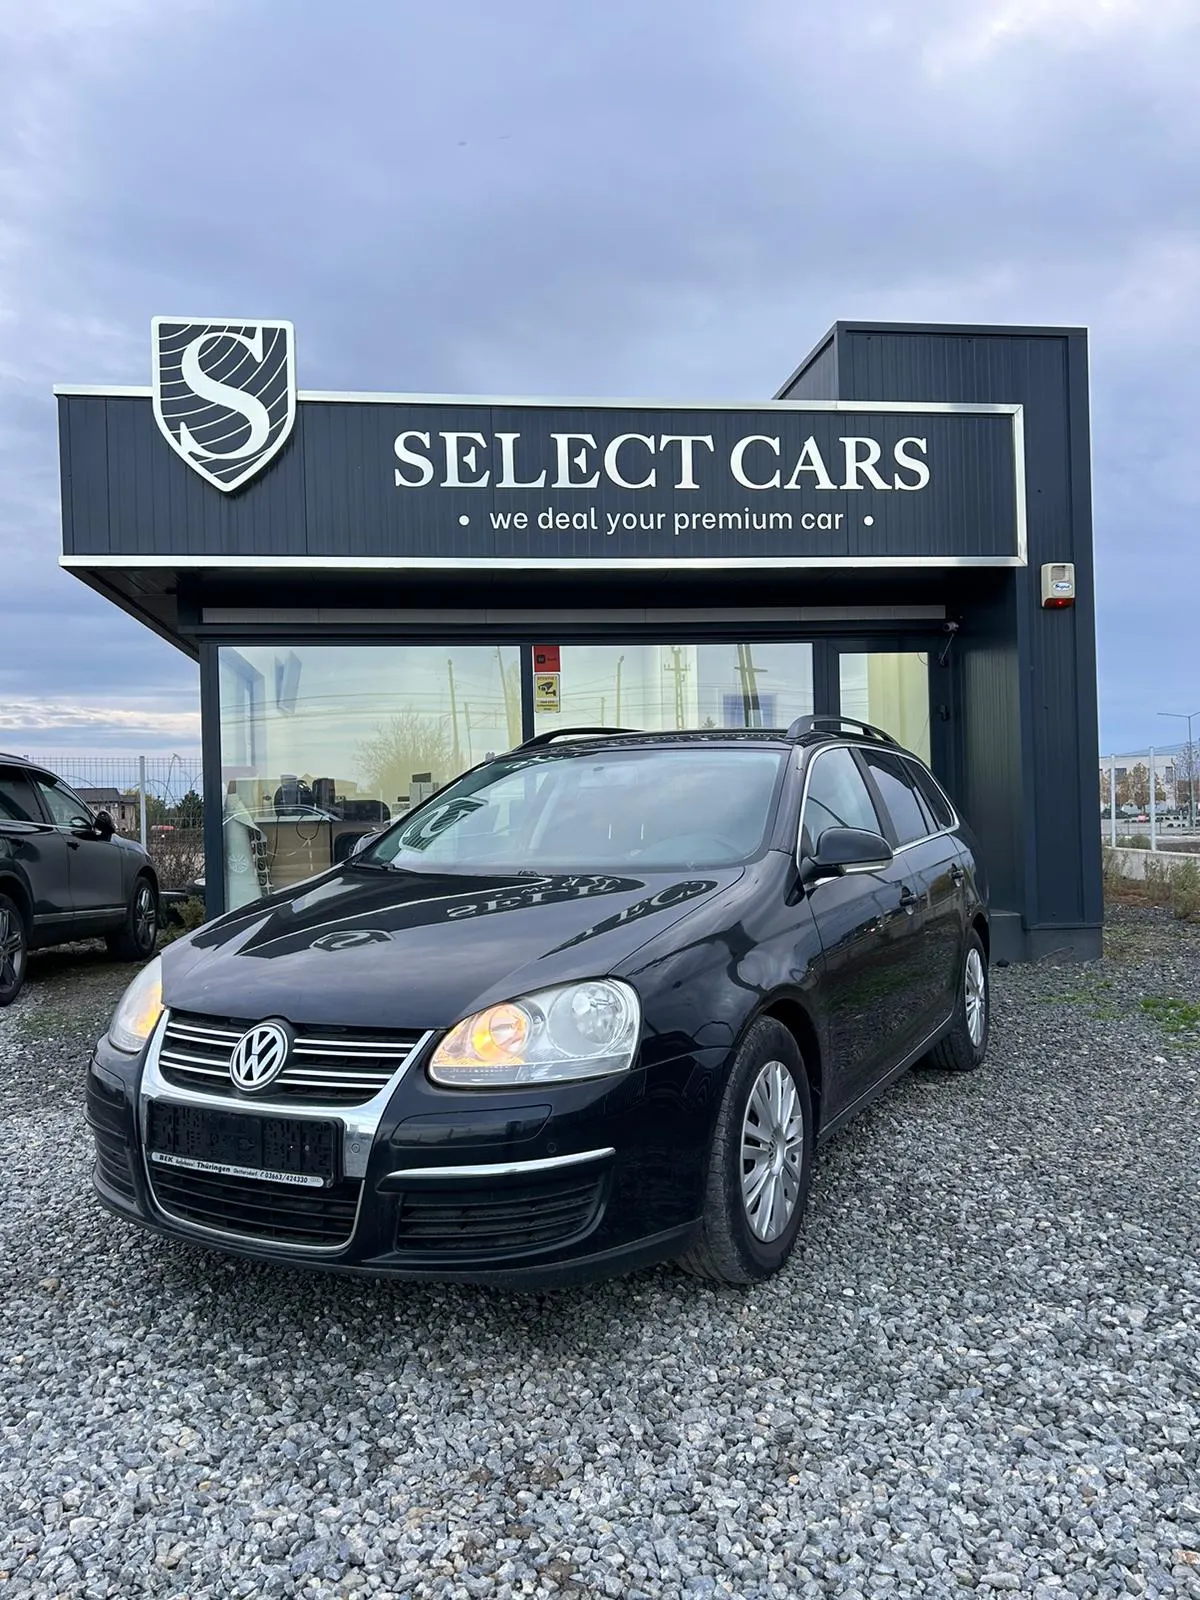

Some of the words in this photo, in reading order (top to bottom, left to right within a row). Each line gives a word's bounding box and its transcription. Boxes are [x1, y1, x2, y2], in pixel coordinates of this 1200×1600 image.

[180, 326, 271, 460] S
[394, 430, 715, 489] SELECT
[730, 434, 931, 491] CARS
[489, 512, 529, 530] we
[537, 507, 598, 530] deal
[606, 512, 666, 535] your
[674, 507, 793, 536] premium
[800, 512, 844, 530] car
[233, 1026, 284, 1086] VW
[197, 1162, 231, 1173] Thüringen
